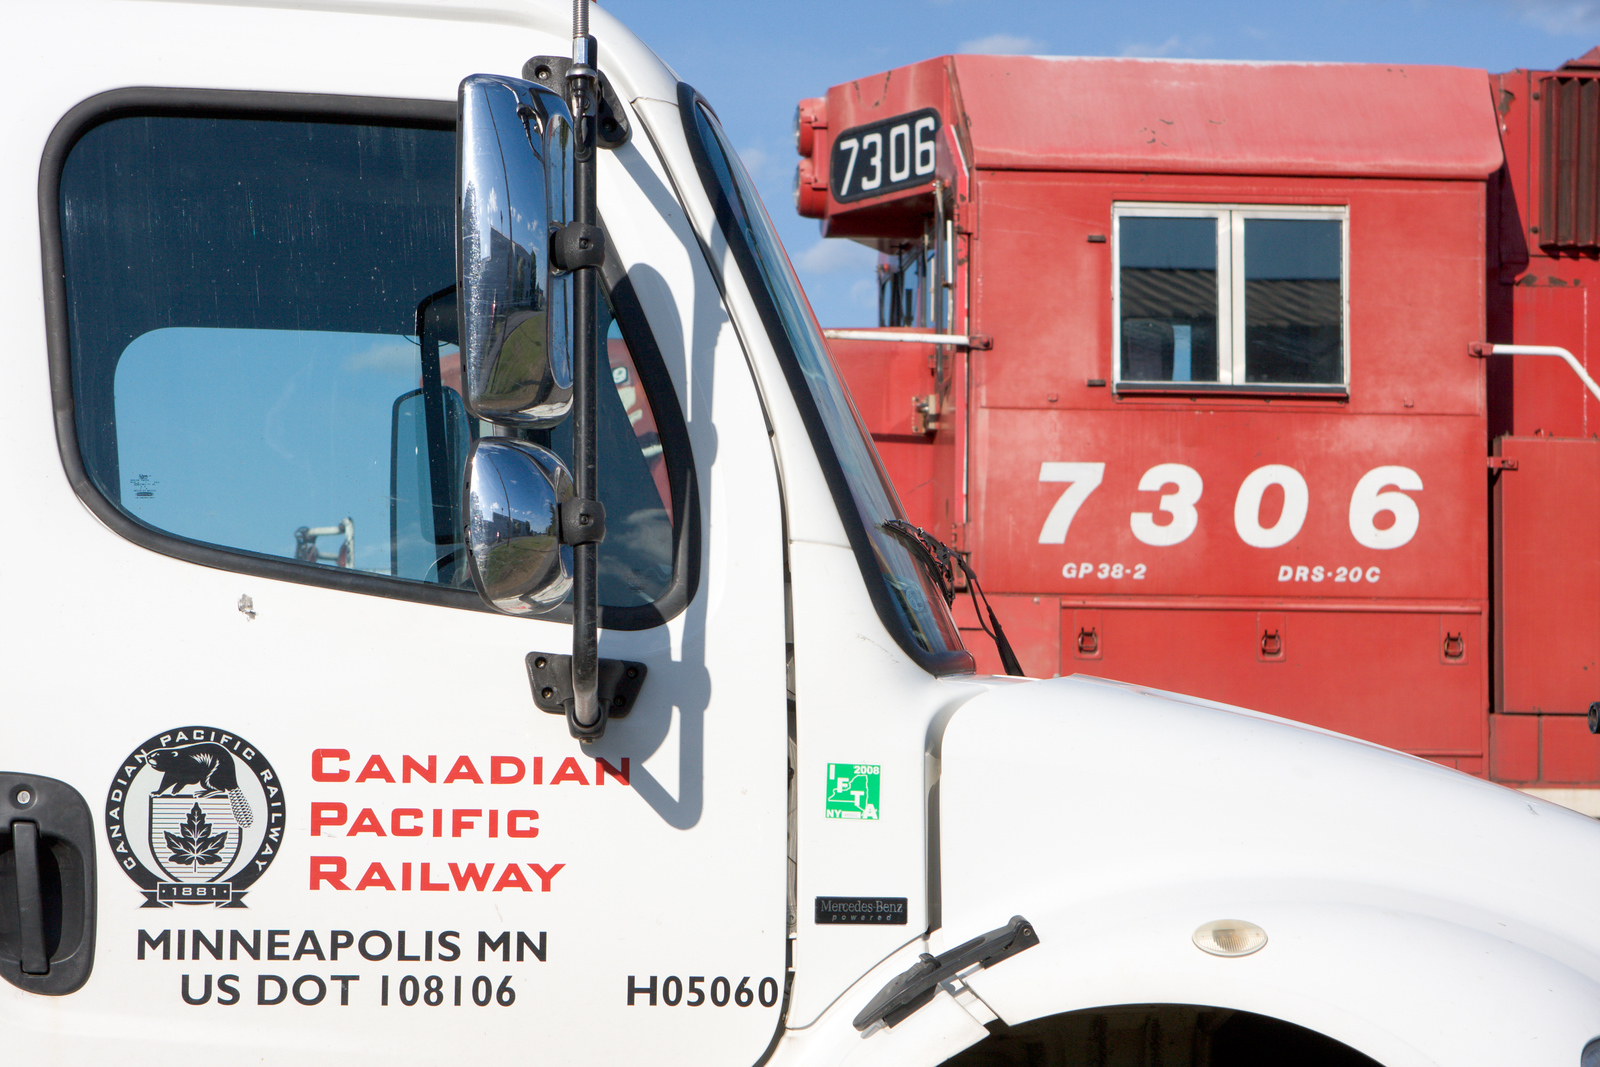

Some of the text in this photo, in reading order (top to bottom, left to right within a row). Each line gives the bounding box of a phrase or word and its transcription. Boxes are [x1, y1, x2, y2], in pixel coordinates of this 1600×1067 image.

[840, 116, 936, 196] 7306
[1038, 461, 1424, 550] 7306
[311, 748, 630, 786] CANADIAN
[853, 765, 880, 775] 2008
[109, 729, 283, 872] CANADIAN PACIFIC RAILWAY
[826, 809, 842, 818] NY
[310, 801, 540, 839] PACIFIC
[309, 855, 566, 892] RAILWAY
[171, 886, 217, 896] 1881
[821, 900, 903, 913] Mercedes-Benz
[831, 913, 892, 921] powered
[137, 929, 547, 962] MINNEAPOLIS MN
[181, 974, 516, 1007] US DOT 108106
[627, 975, 779, 1008] H05060
